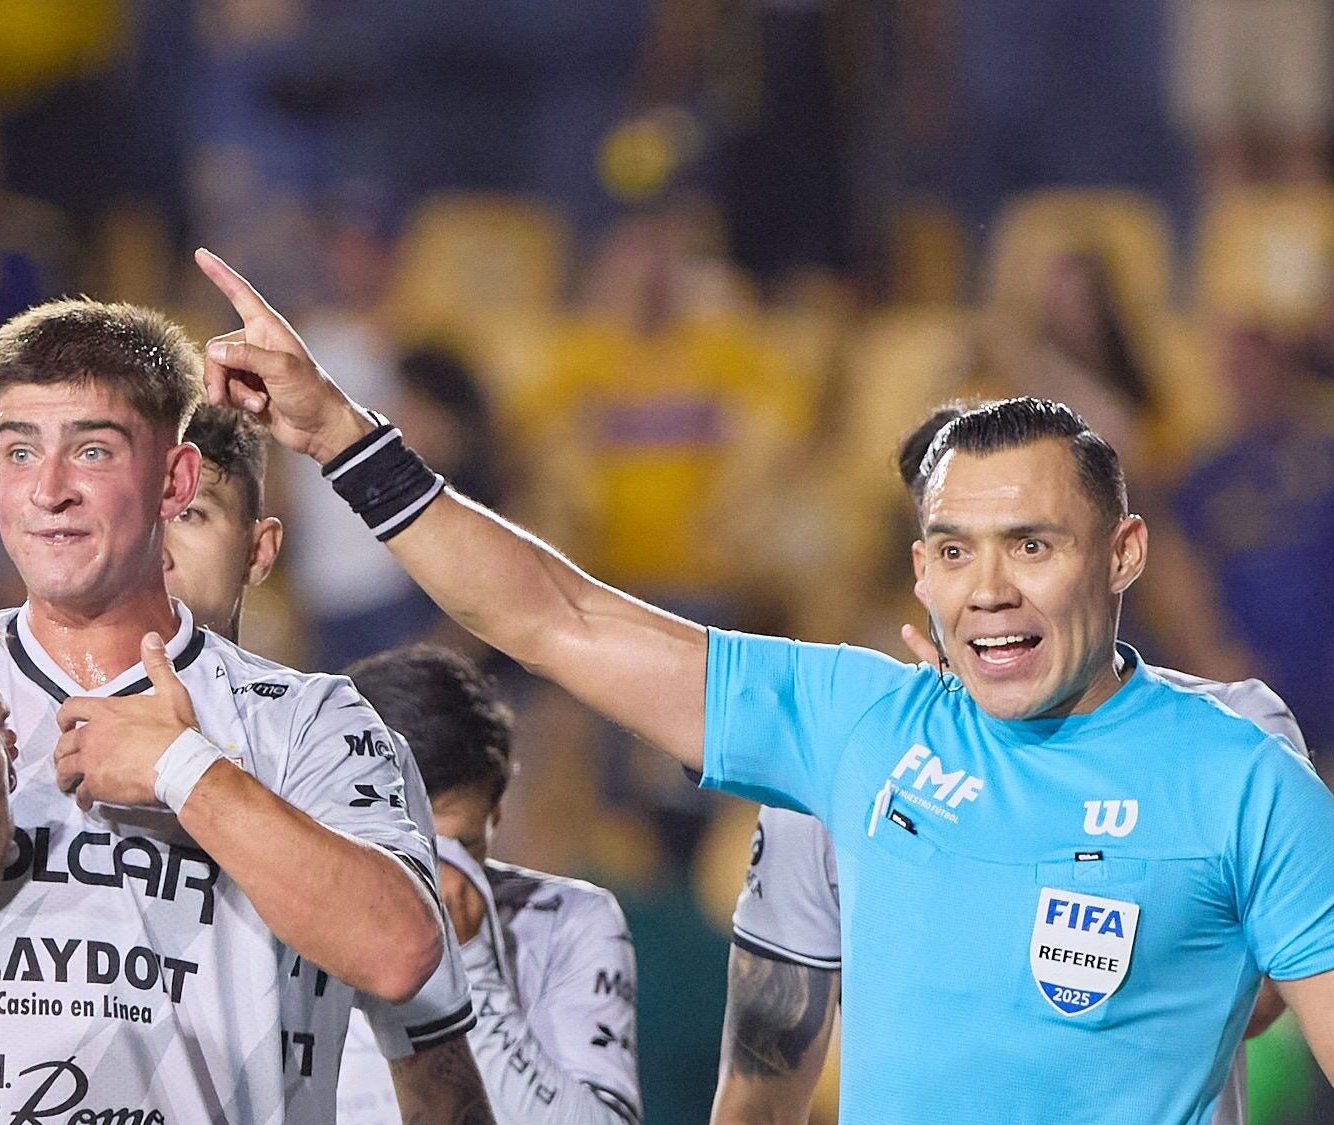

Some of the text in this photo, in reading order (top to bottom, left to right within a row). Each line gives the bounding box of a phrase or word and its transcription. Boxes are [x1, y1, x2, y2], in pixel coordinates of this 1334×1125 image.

[891, 743, 984, 809] FMF
[3, 825, 220, 926] OLCAR
[1045, 898, 1125, 939] FIFA
[1038, 945, 1120, 973] REFEREE
[70, 997, 95, 1018] en
[103, 994, 153, 1025] Línea
[1052, 987, 1092, 1007] 2025
